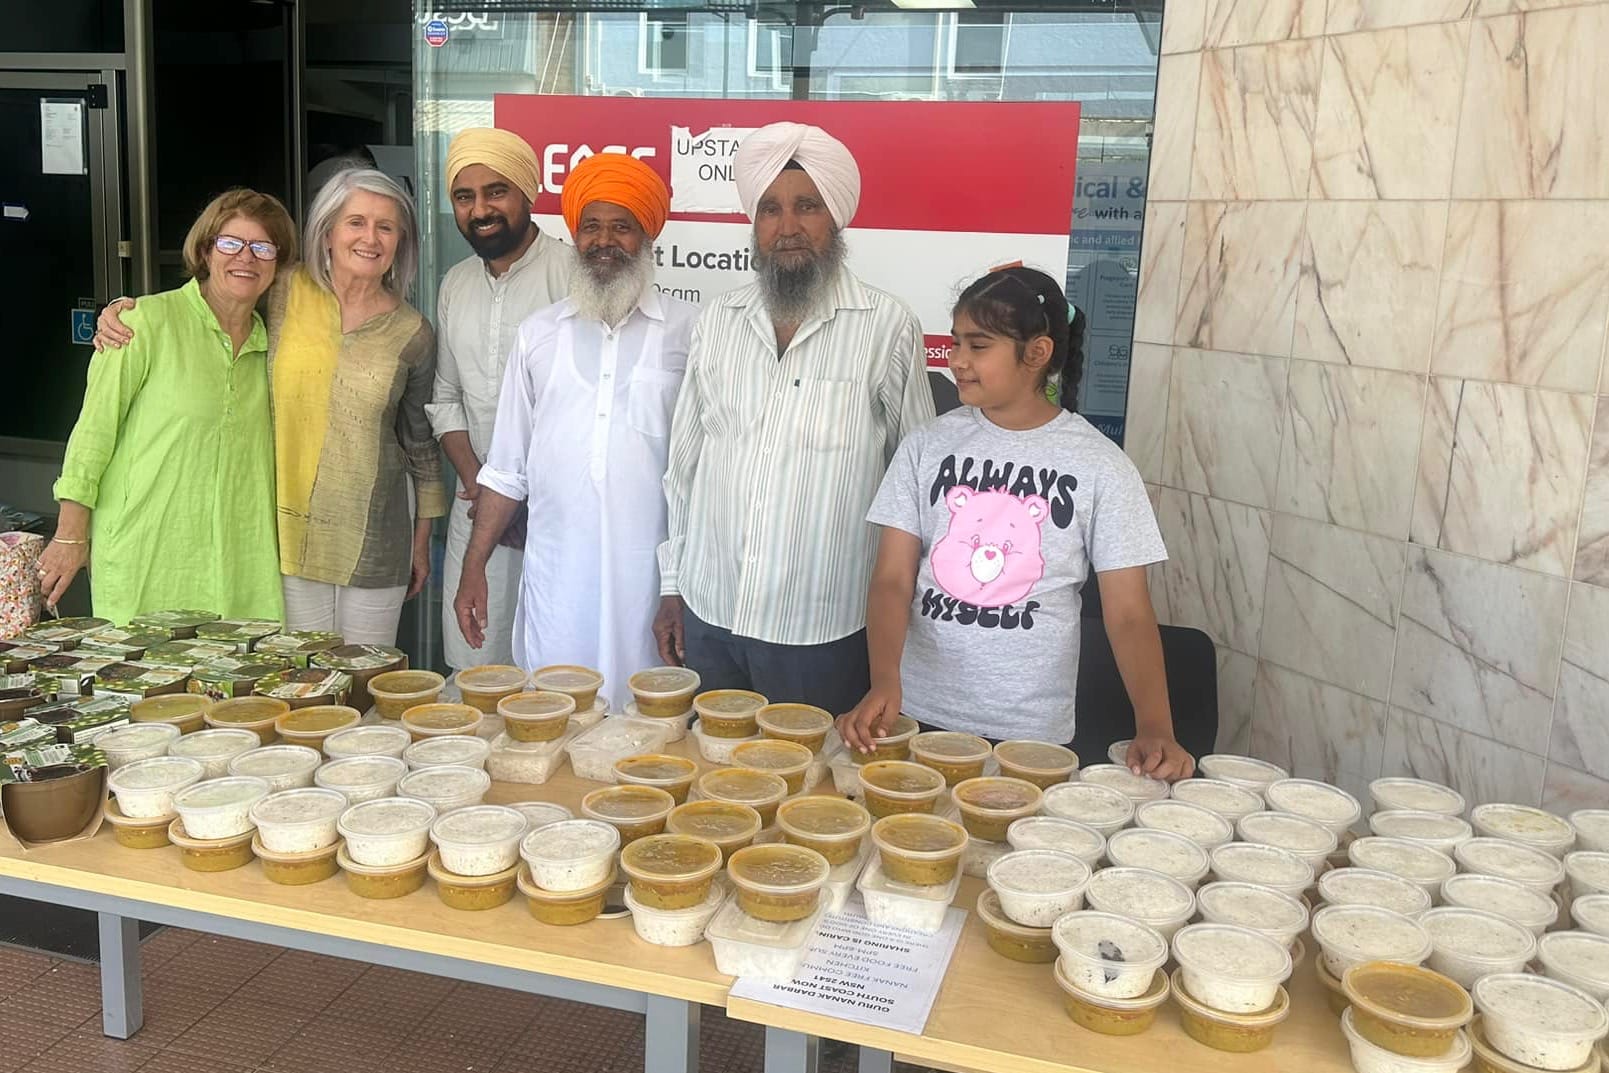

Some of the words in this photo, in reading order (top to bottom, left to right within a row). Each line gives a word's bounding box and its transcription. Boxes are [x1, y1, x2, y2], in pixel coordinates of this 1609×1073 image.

[677, 138, 740, 157] UPSTA
[699, 164, 736, 181] ONL
[1076, 175, 1118, 198] ical
[1126, 176, 1145, 198] &
[1095, 206, 1129, 220] with
[1082, 235, 1102, 245] and
[1105, 235, 1135, 246] allied
[930, 454, 1078, 530] ALWAYS
[921, 588, 1040, 630] MYSELF
[864, 940, 910, 953] SHARING
[831, 948, 861, 960] EVERY
[800, 962, 843, 975] COMMU
[826, 959, 870, 973] KITCHEN
[862, 957, 891, 968] FOOD
[894, 963, 919, 973] FREE
[813, 975, 838, 984] 2541
[845, 971, 870, 981] FREE
[772, 983, 816, 997] DARBAR
[820, 984, 855, 996] COAST
[839, 980, 865, 990] NSW
[873, 978, 908, 989] NANAK
[819, 993, 856, 1006] NANAK
[857, 992, 895, 1005] SOUTH
[858, 1001, 890, 1013] GURU
